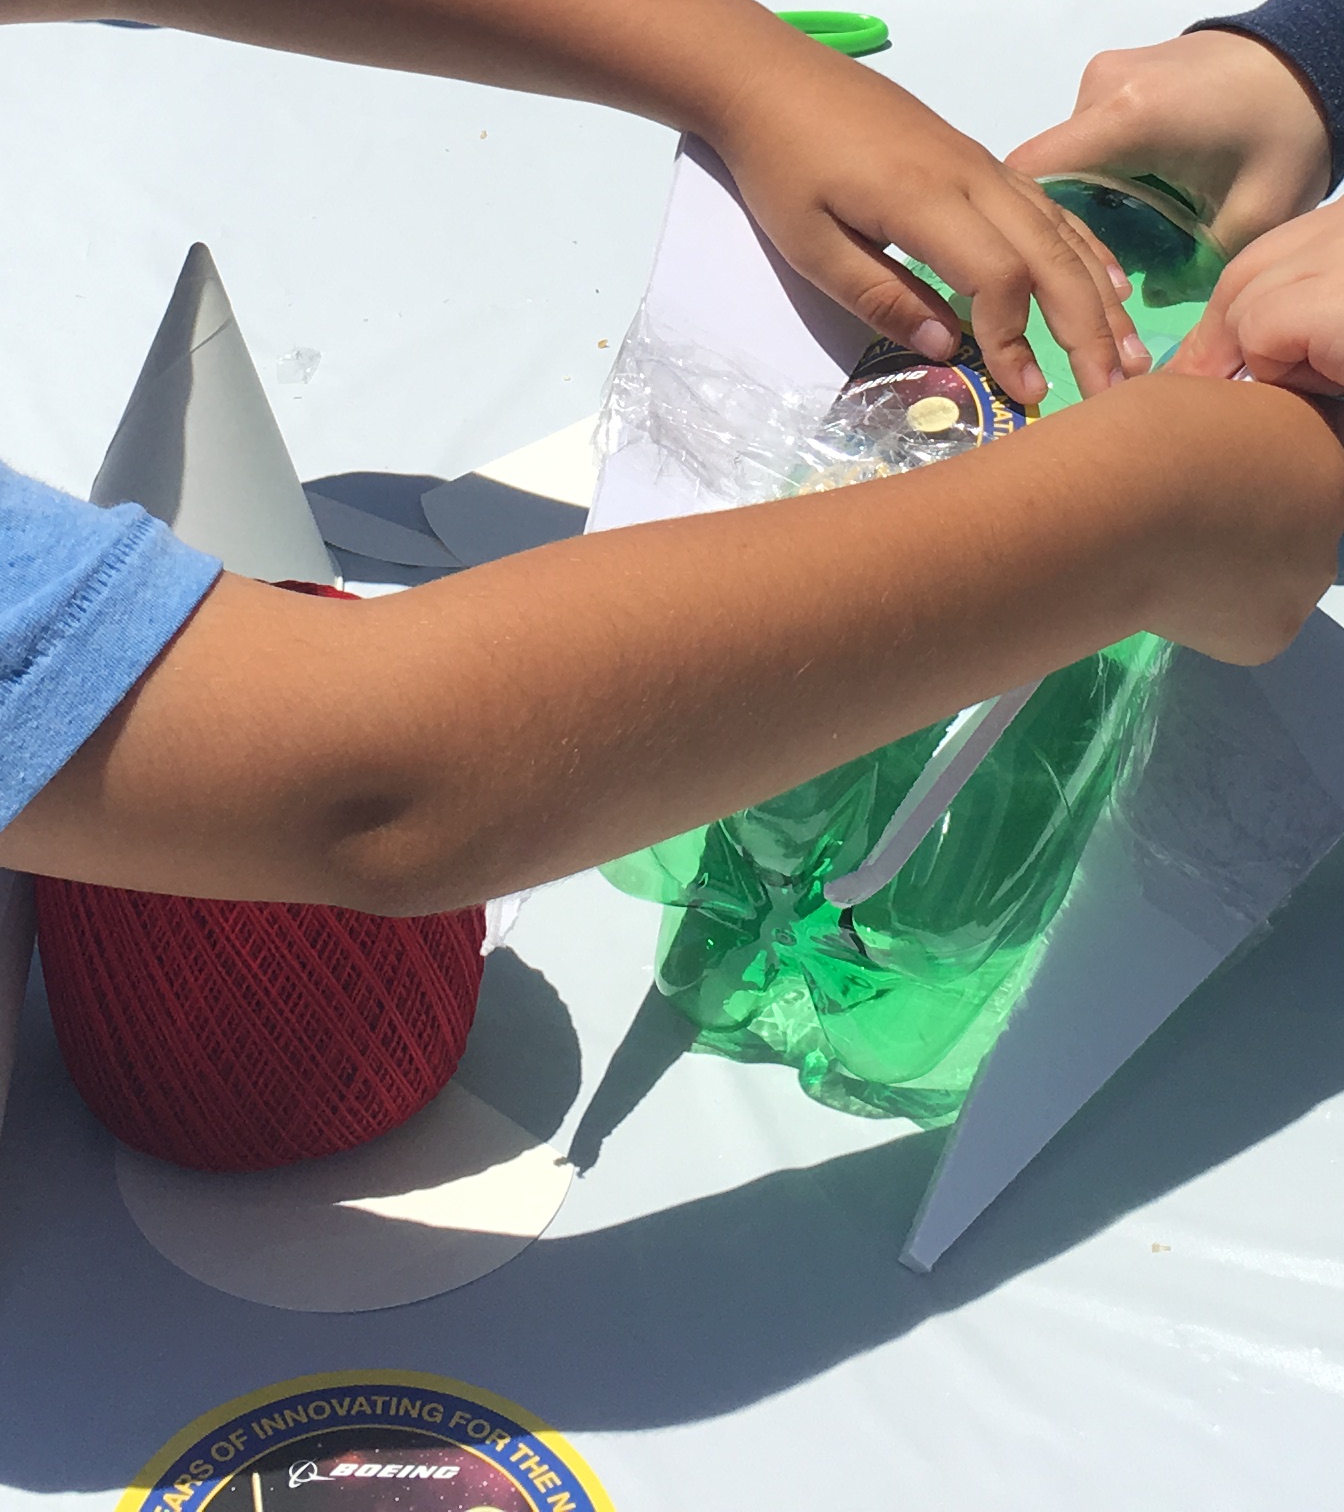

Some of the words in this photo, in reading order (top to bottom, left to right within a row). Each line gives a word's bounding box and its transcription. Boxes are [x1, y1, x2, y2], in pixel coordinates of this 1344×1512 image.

[210, 1429, 249, 1463] OF
[251, 1395, 444, 1439] INNOVATING
[448, 1410, 512, 1453] FOR
[509, 1441, 563, 1494] THE
[329, 1463, 461, 1479] BOEING
